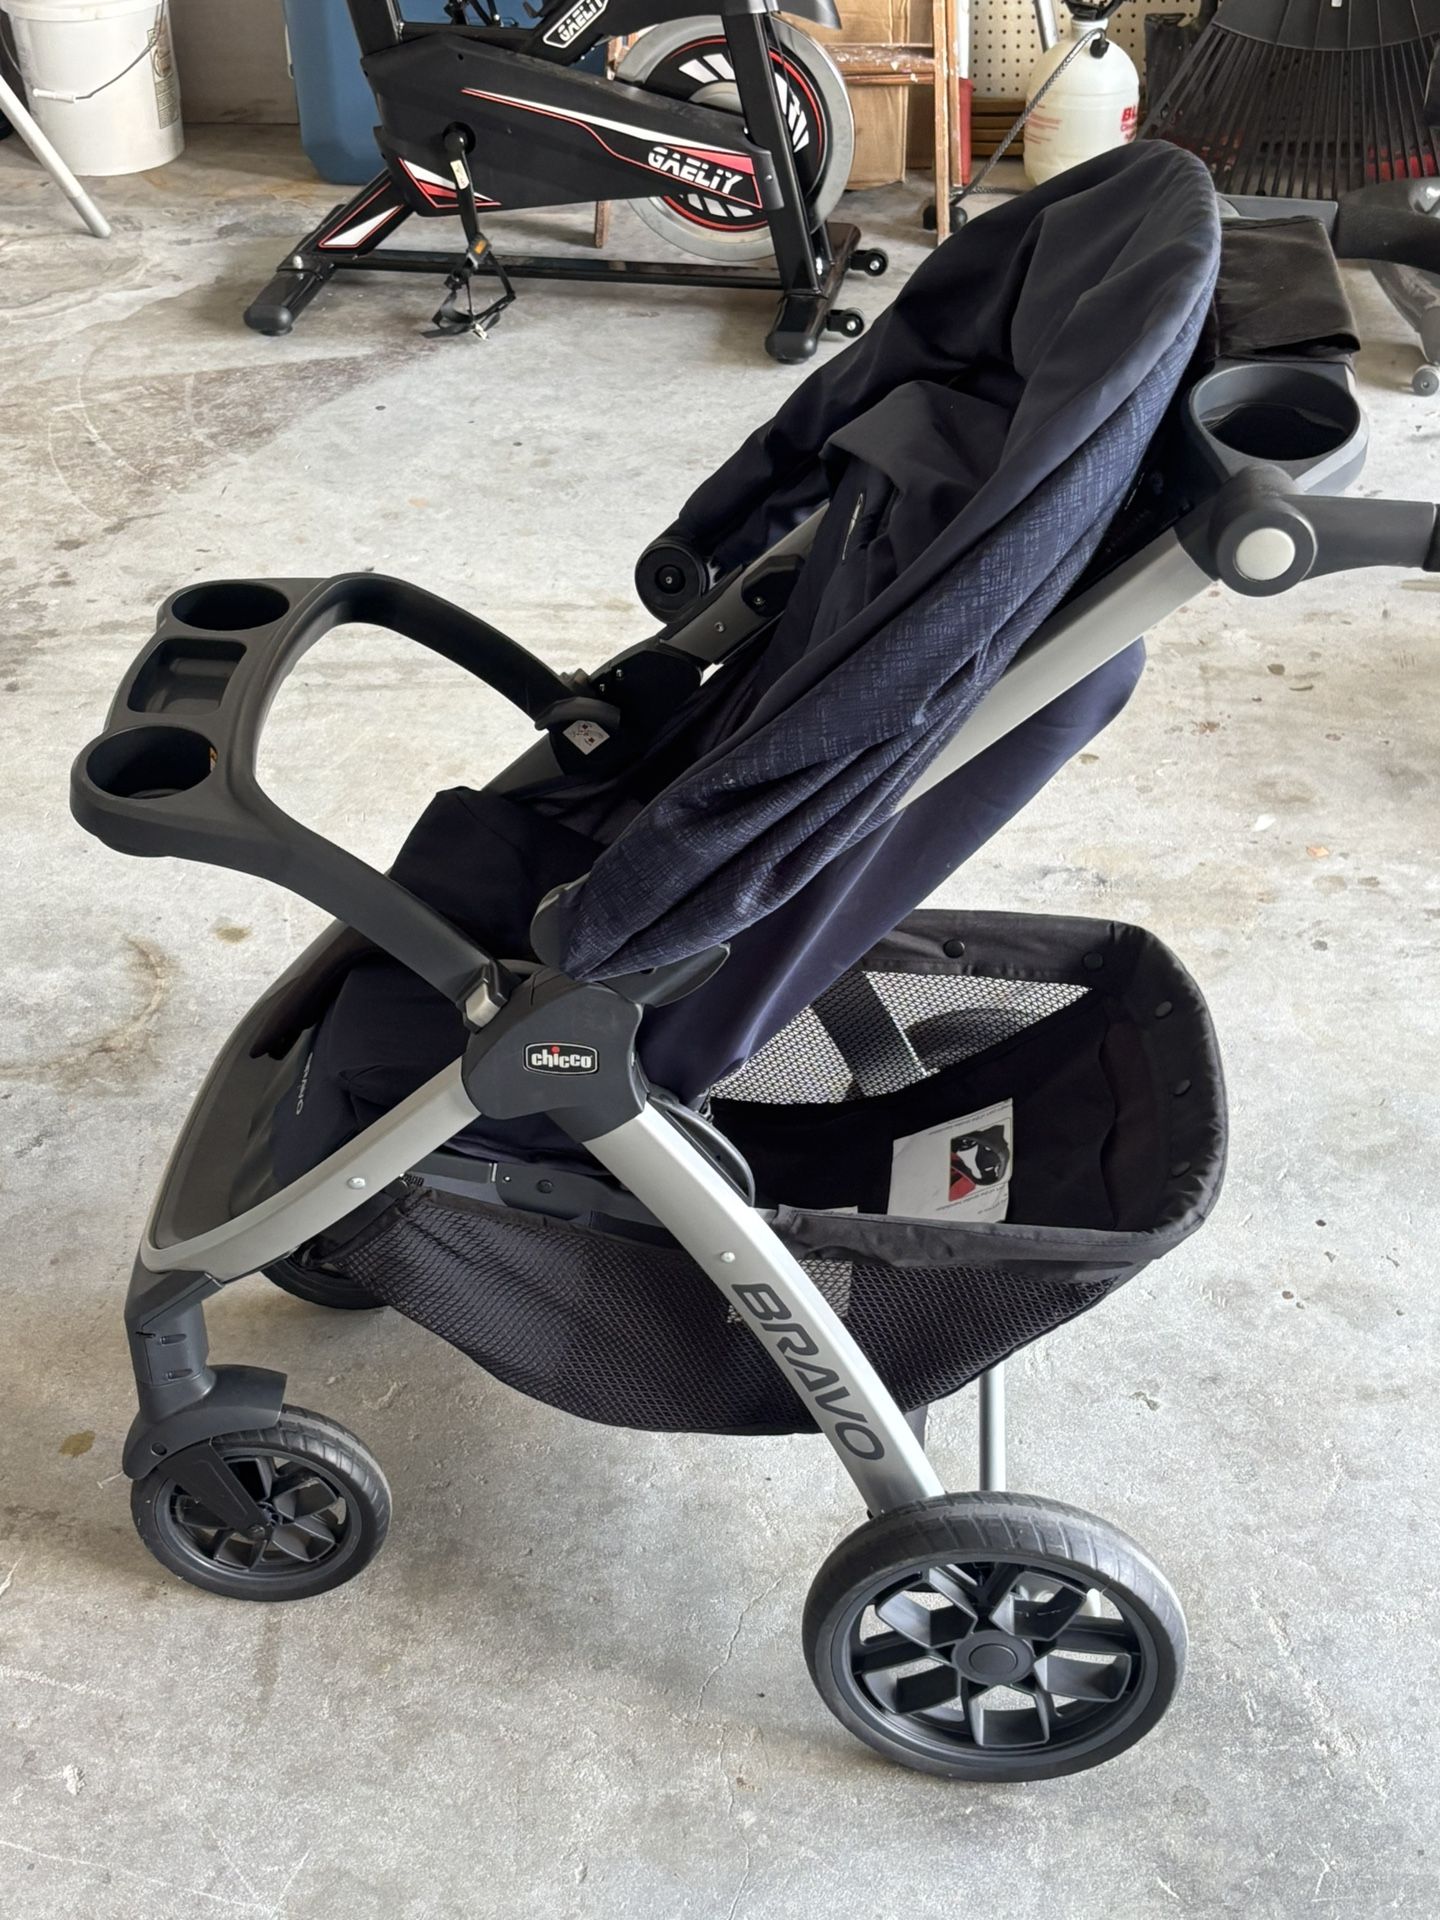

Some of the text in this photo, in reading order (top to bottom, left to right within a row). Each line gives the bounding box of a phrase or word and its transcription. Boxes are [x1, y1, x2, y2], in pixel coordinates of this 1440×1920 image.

[647, 146, 744, 195] GAELIY
[530, 1045, 593, 1069] chicco
[731, 1283, 886, 1461] BRAVO
